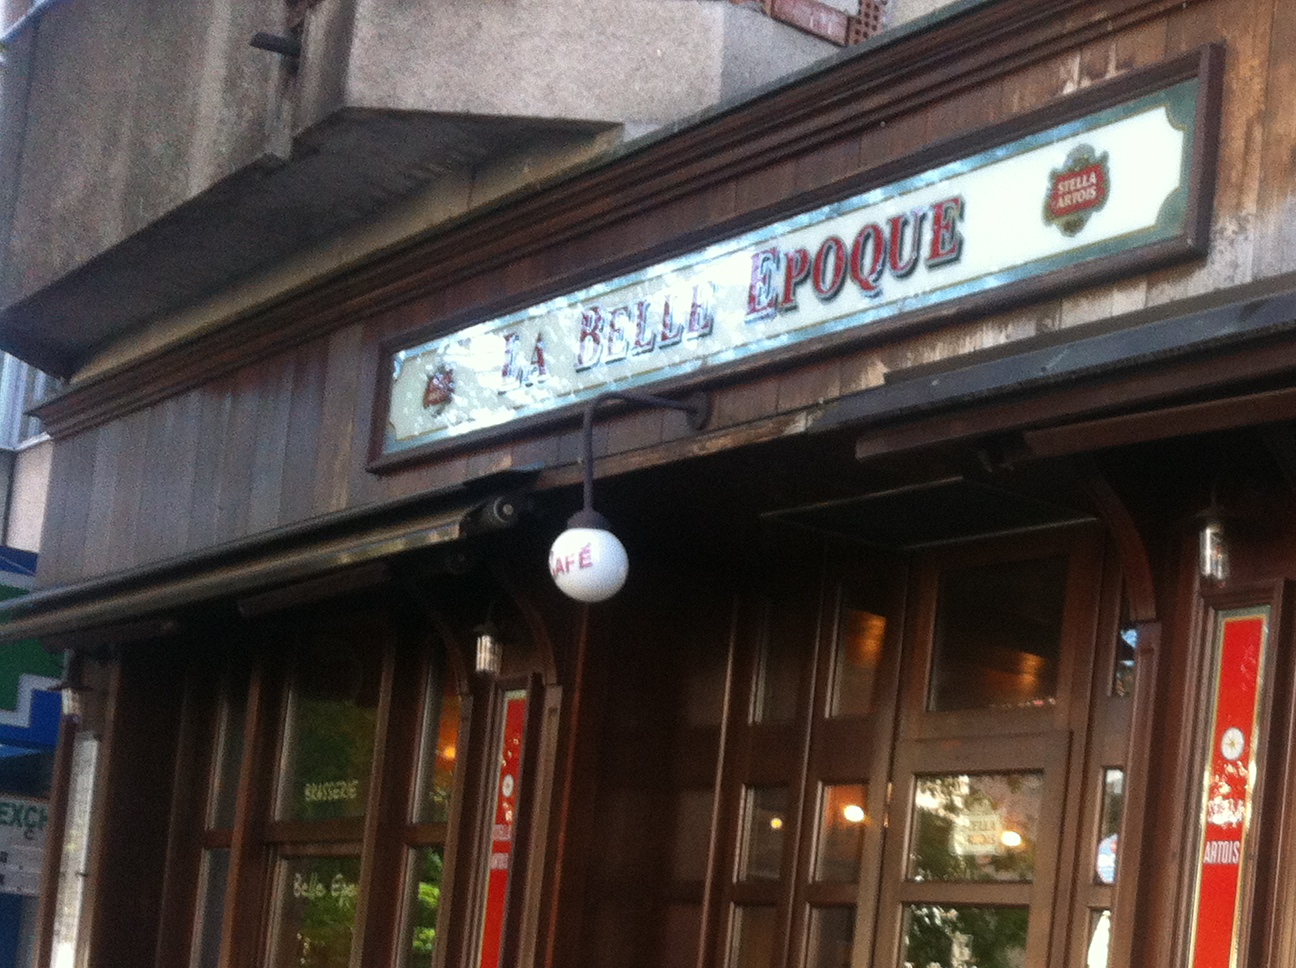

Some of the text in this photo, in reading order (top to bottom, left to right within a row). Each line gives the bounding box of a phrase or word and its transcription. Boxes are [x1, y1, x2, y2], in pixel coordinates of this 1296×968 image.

[1057, 171, 1098, 195] STELLA
[1056, 185, 1098, 209] ARTOIS
[577, 281, 715, 373] BELLE
[1203, 840, 1240, 864] ARTOIS
